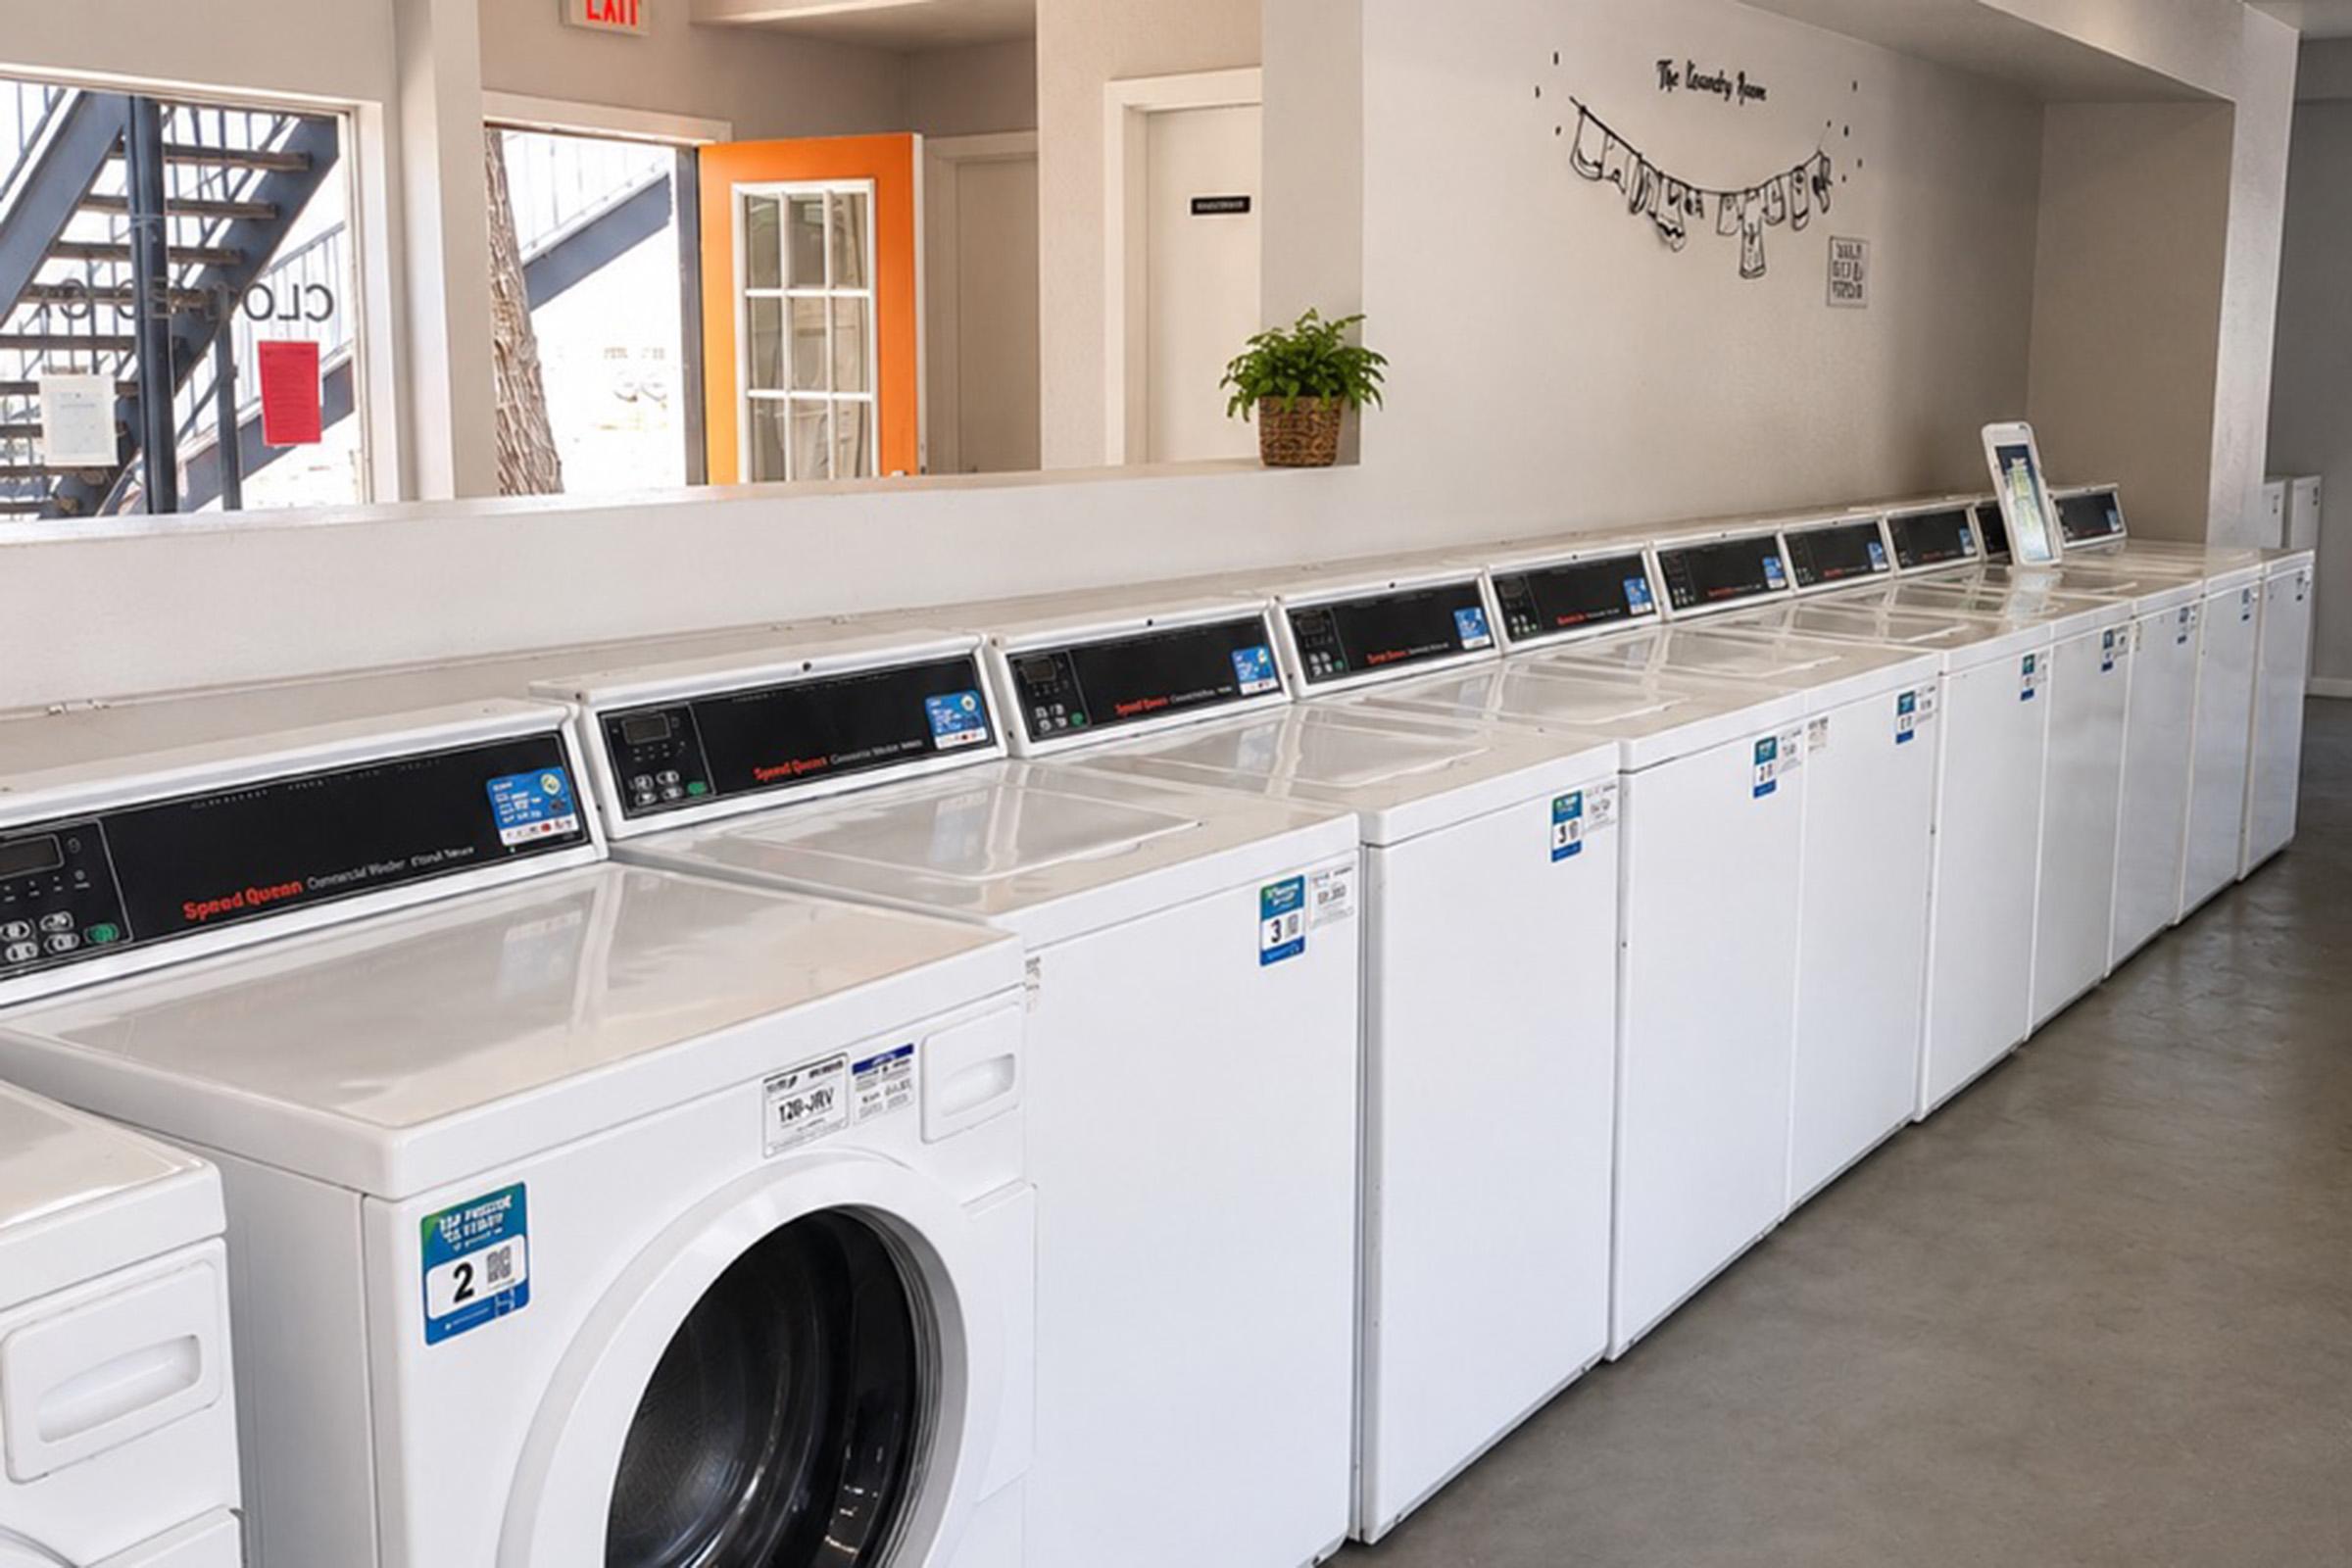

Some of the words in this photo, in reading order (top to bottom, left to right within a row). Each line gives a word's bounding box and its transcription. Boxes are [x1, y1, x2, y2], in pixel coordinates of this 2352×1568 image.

[585, 0, 640, 31] EXIT
[1656, 59, 1679, 92] The
[453, 1261, 474, 1304] 2
